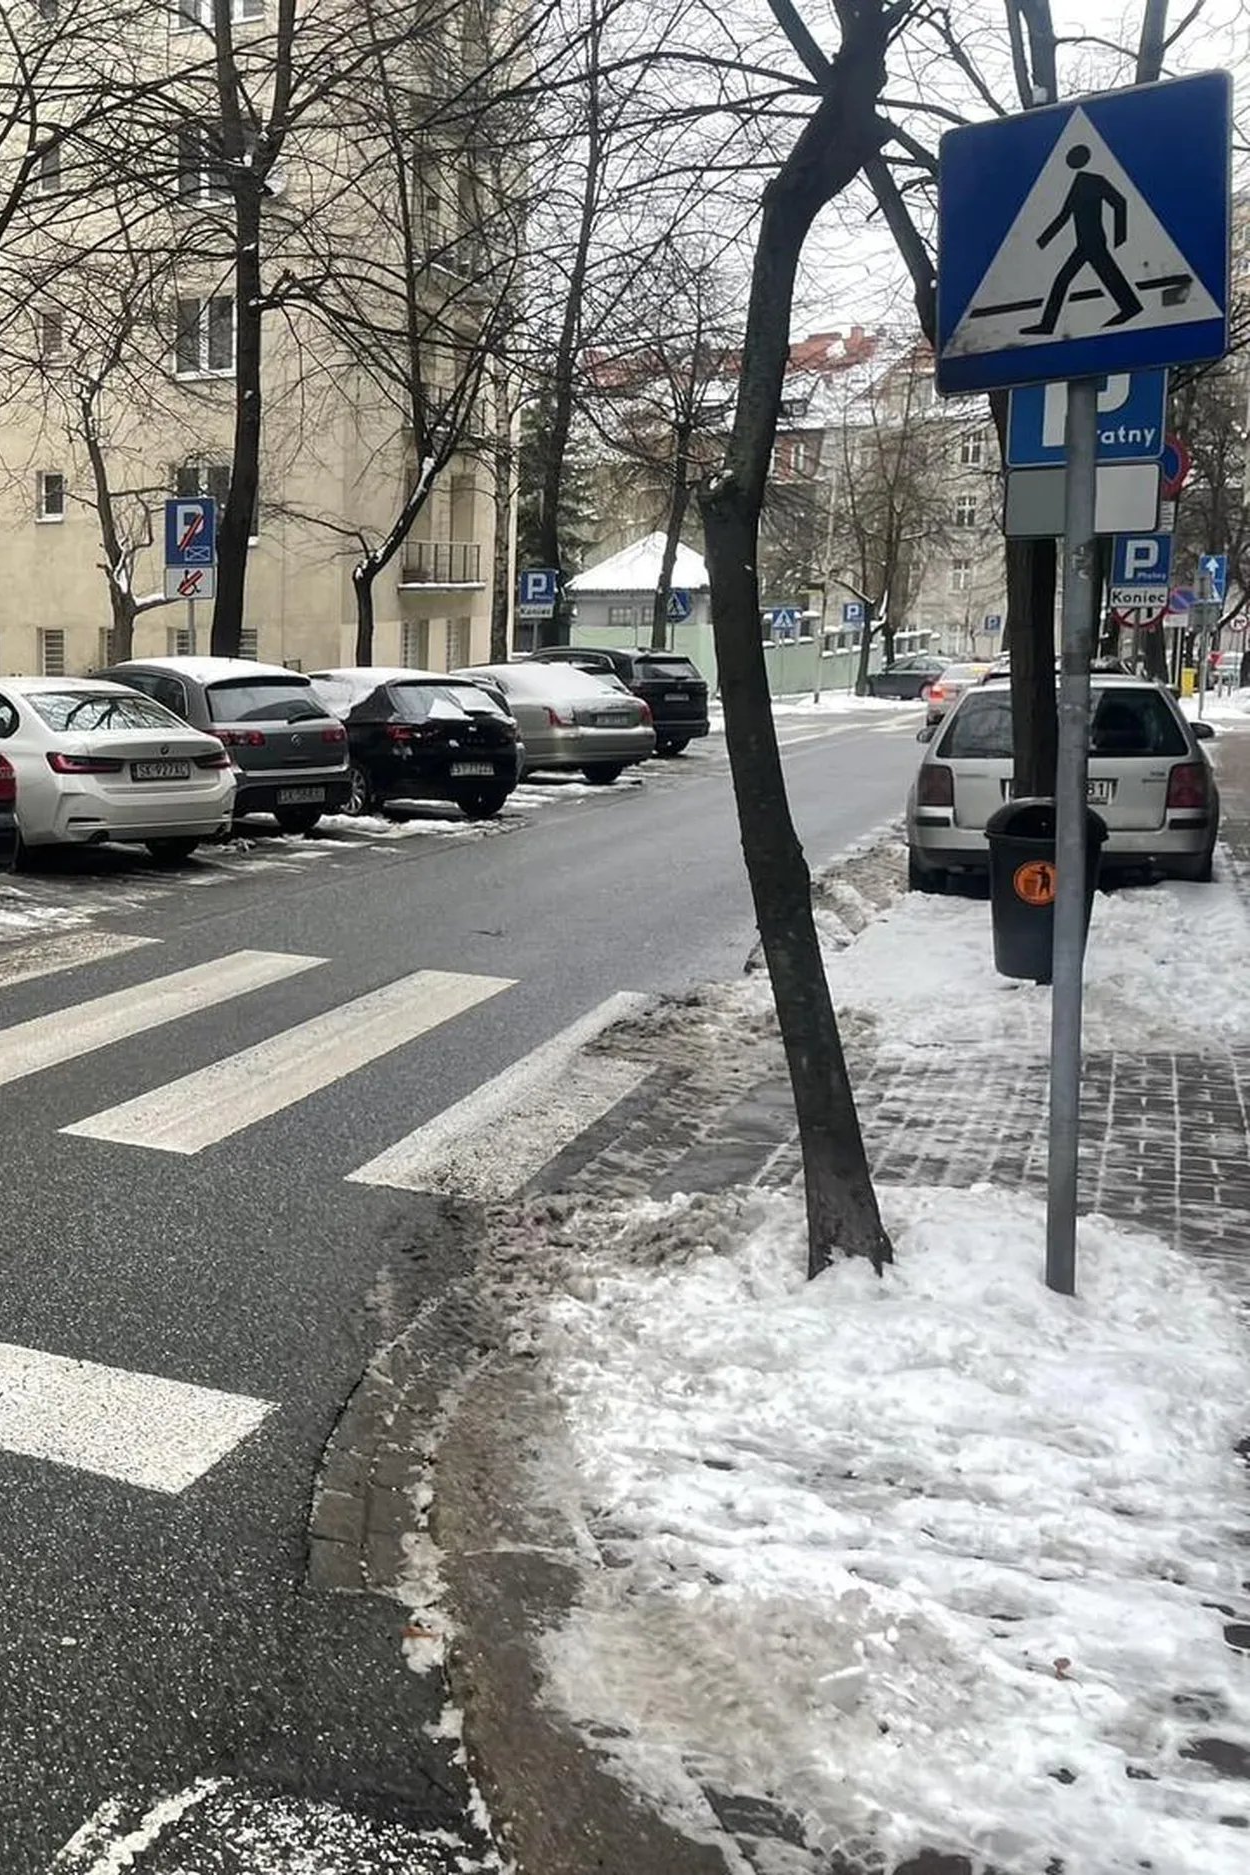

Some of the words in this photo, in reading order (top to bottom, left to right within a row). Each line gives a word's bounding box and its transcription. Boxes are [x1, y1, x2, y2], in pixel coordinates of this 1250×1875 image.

[1125, 539, 1159, 580] P
[527, 573, 547, 600] P
[1112, 591, 1165, 603] Koniec
[847, 605, 860, 620] P
